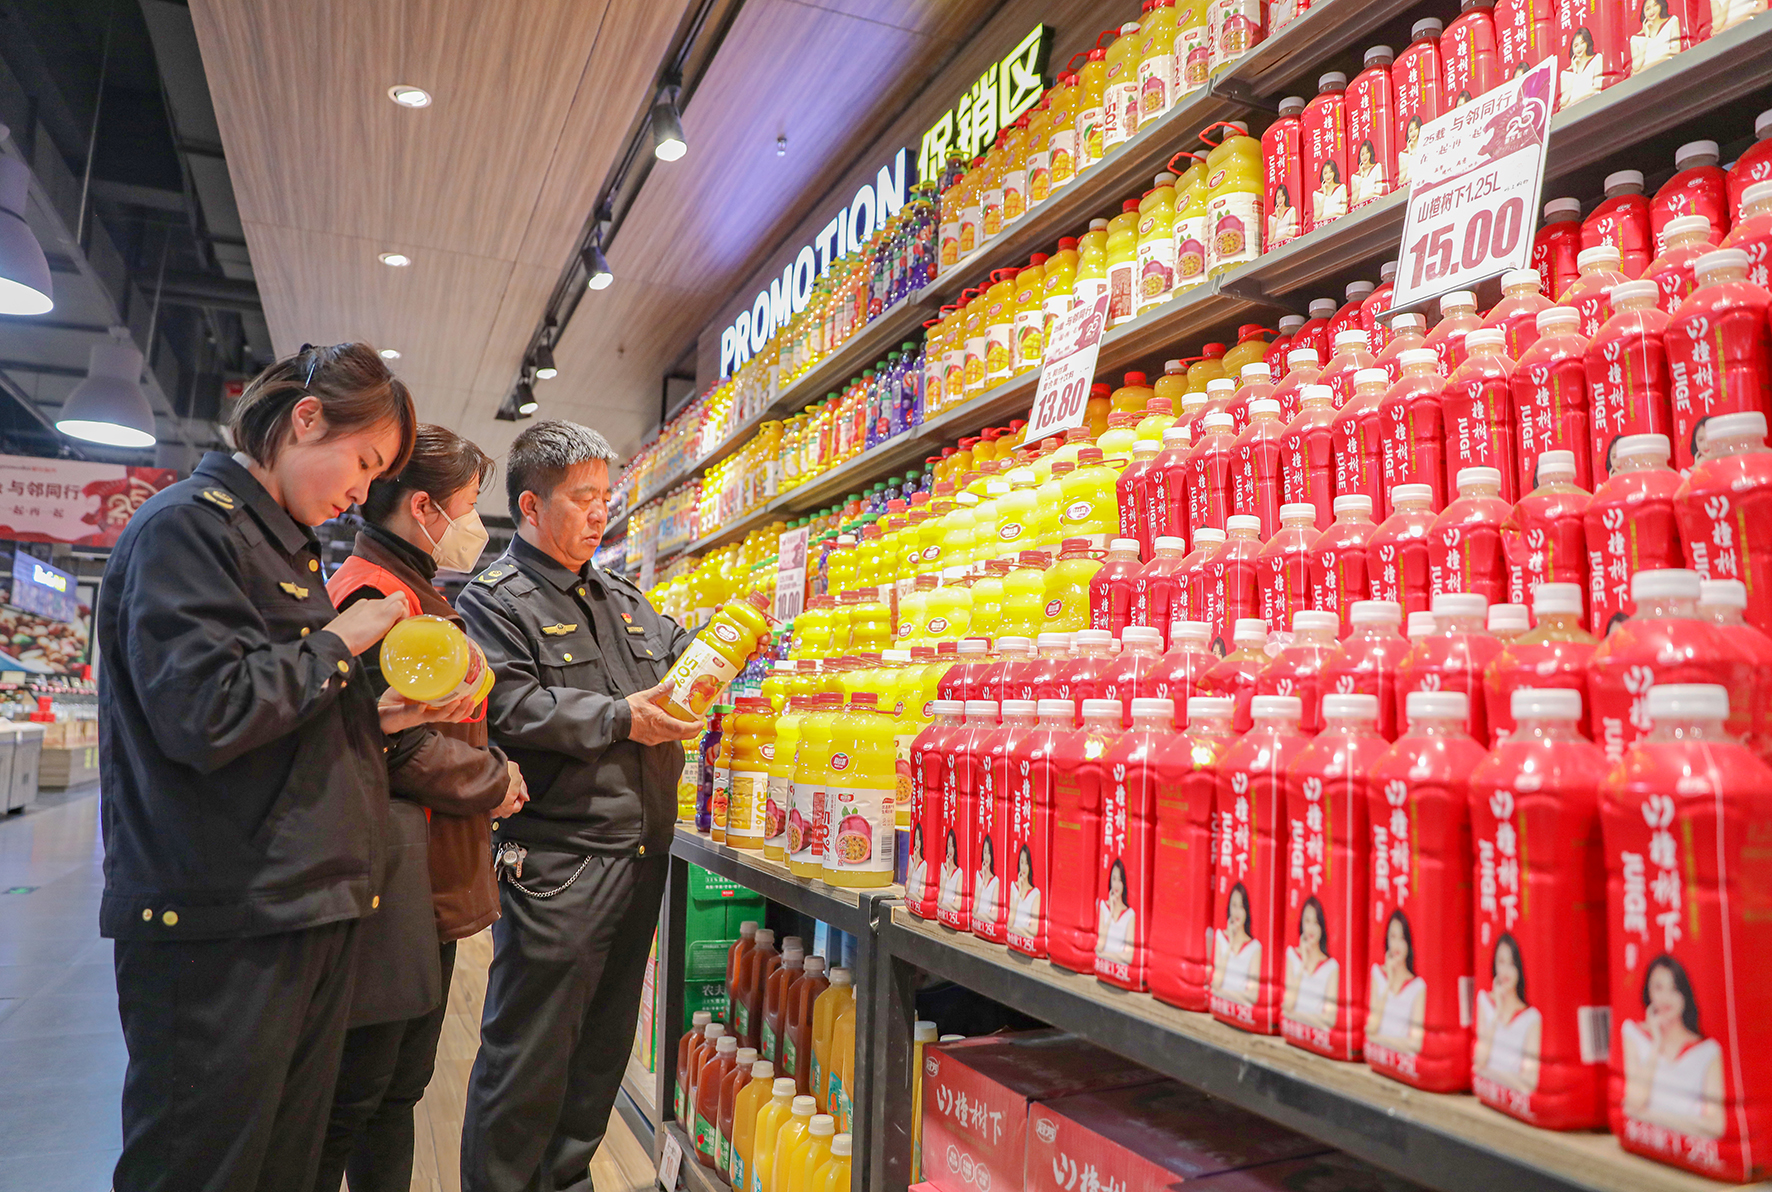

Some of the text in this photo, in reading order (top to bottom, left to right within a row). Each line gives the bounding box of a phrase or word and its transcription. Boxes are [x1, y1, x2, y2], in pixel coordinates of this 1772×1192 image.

[1104, 102, 1118, 137] 50%
[1450, 91, 1512, 131] 与邻同行
[720, 147, 906, 378] PROMOTION
[1410, 196, 1524, 290] 15.00
[1035, 377, 1085, 430] 13.80
[7, 480, 81, 500] 与邻同行
[778, 590, 800, 620] 10.00
[672, 656, 698, 688] 50%
[936, 1083, 1002, 1145] 山楂树下
